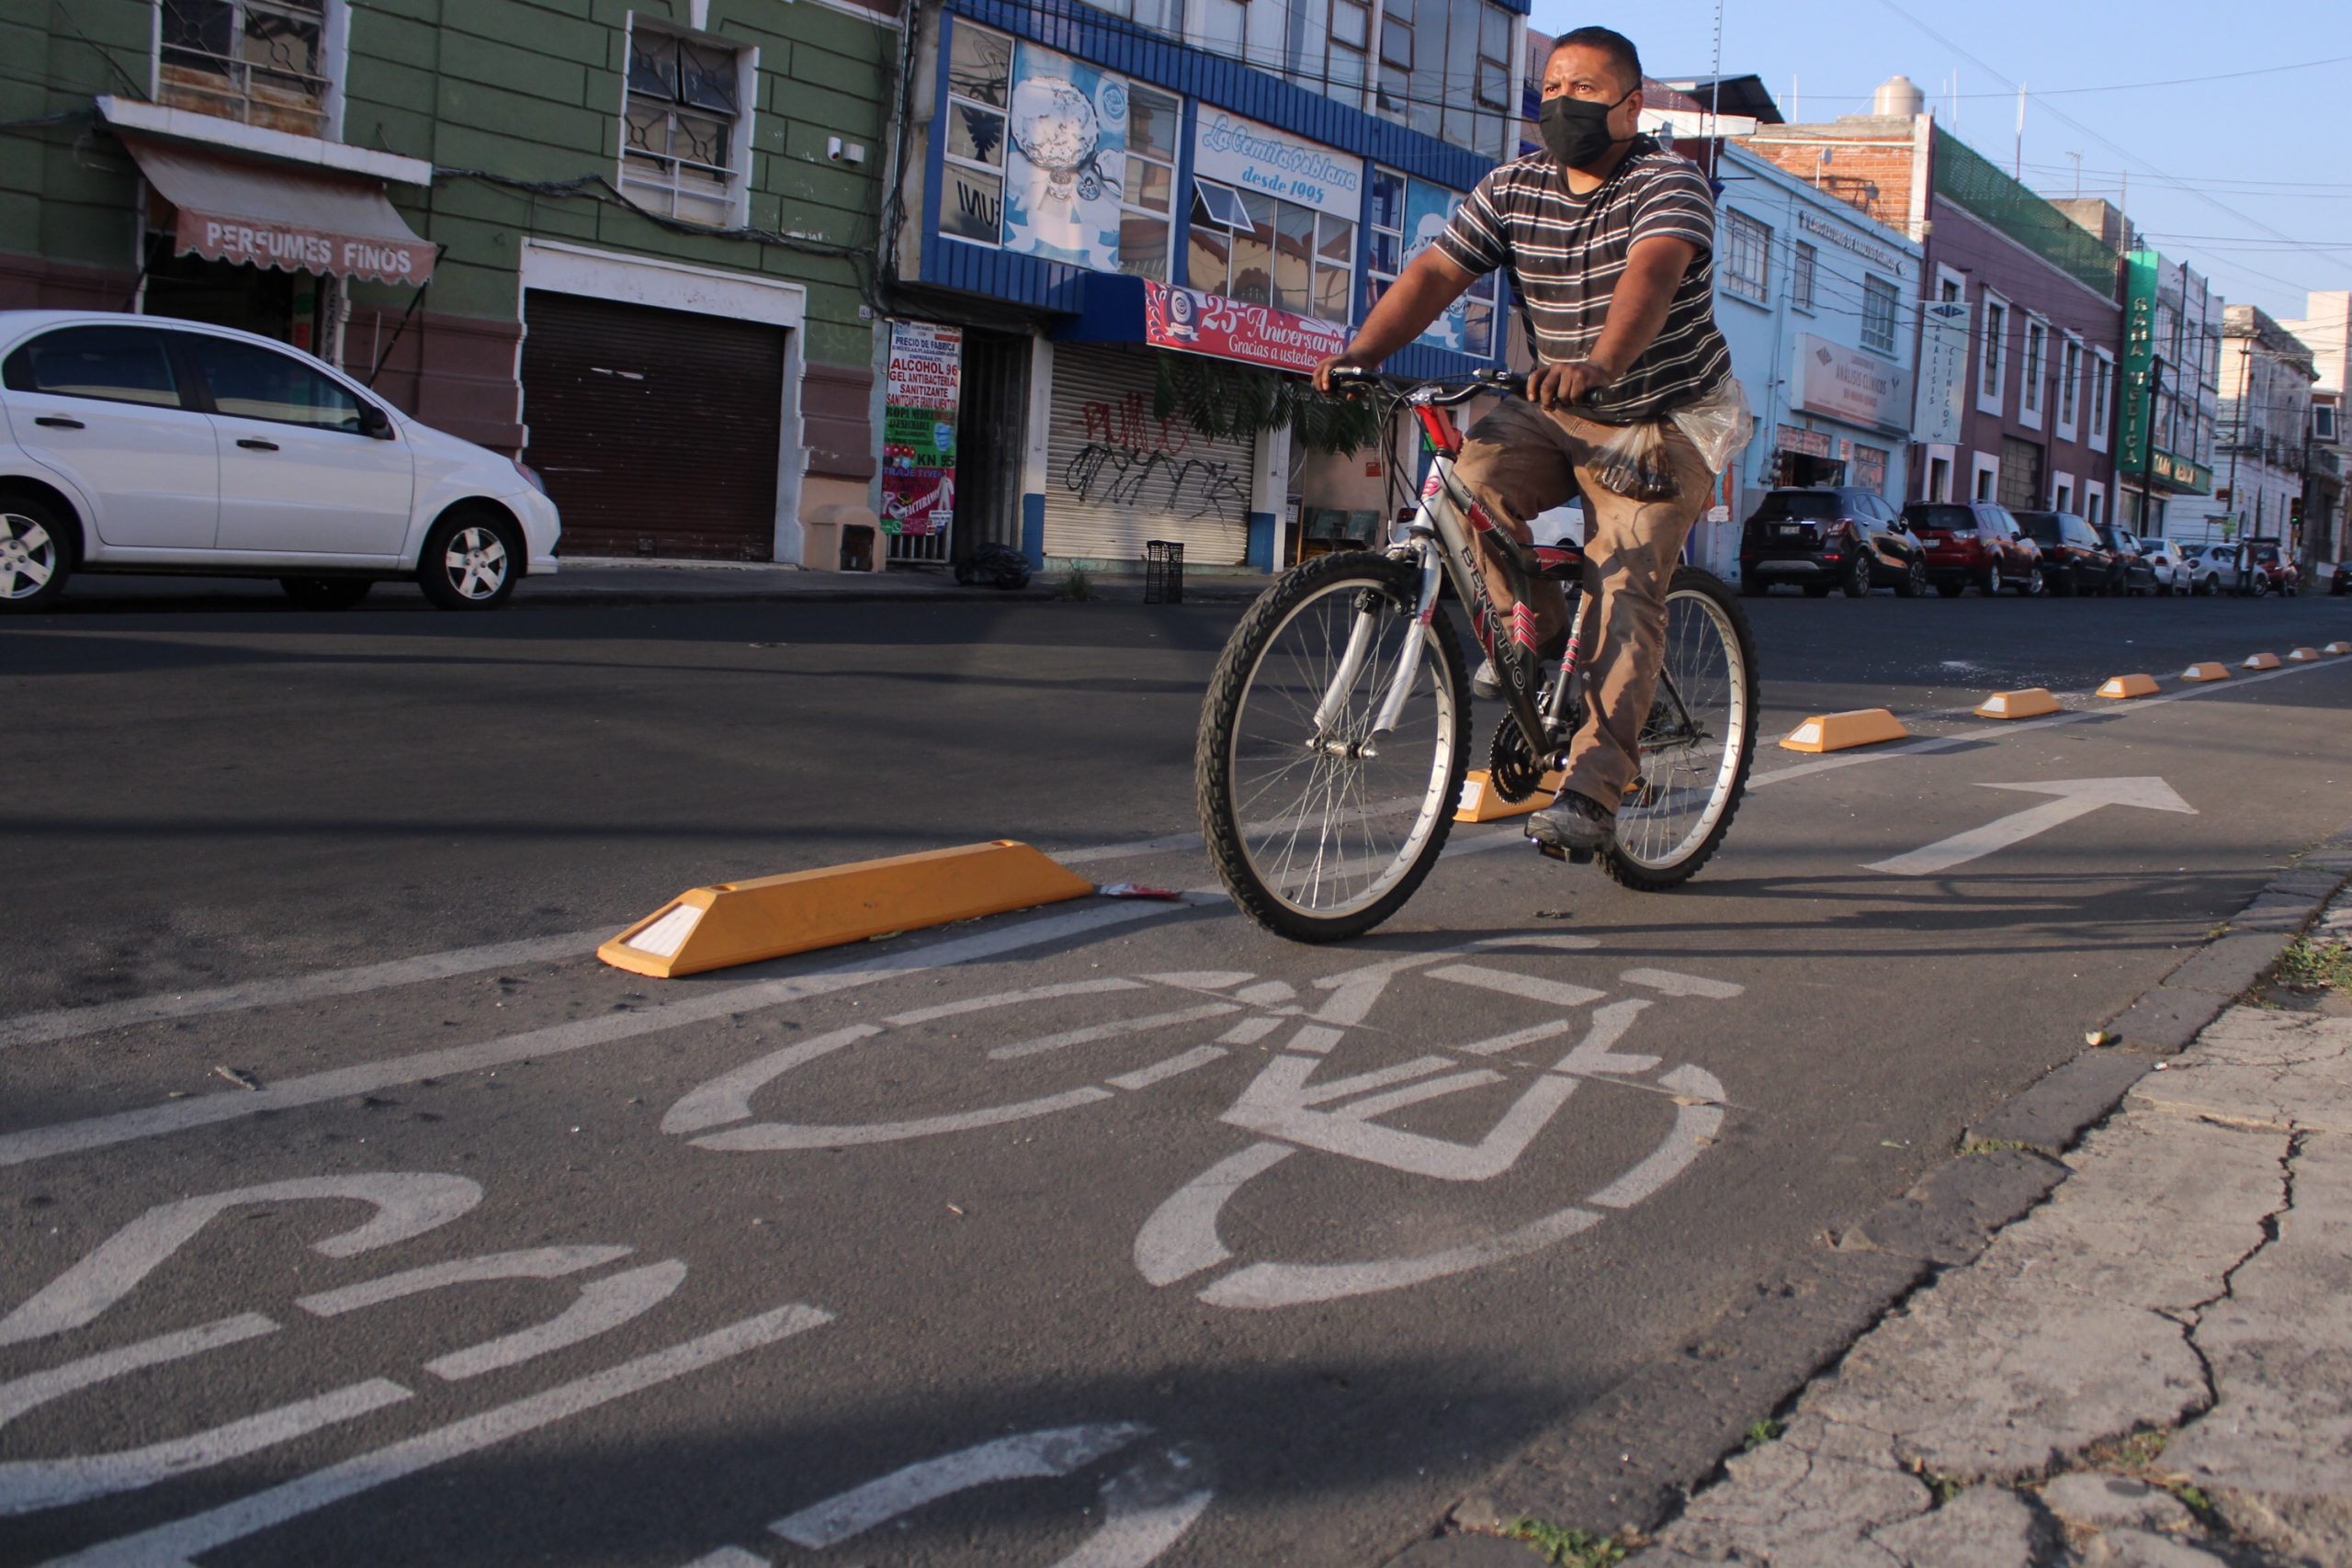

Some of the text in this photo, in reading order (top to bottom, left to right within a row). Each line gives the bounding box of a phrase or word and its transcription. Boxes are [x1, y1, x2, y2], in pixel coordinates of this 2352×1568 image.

[1202, 113, 1358, 191] La Cemita Poblana
[1242, 165, 1326, 204] desde 1995
[206, 221, 333, 264] PERFUMES
[895, 336, 956, 351] PRECIO DE FABRICA
[1247, 307, 1344, 355] Aniversario
[890, 357, 957, 376] ALCOHOL 96
[1228, 333, 1318, 368] Gracias a ustedes
[1929, 323, 1942, 405] ANALISIS
[889, 370, 907, 382] GEL
[899, 383, 948, 398] SANITIZANTE
[1942, 346, 1956, 428] CLINICOS
[882, 467, 915, 477] TRAJE
[917, 453, 956, 467] KN 95
[1461, 546, 1526, 690] BENOTTO
